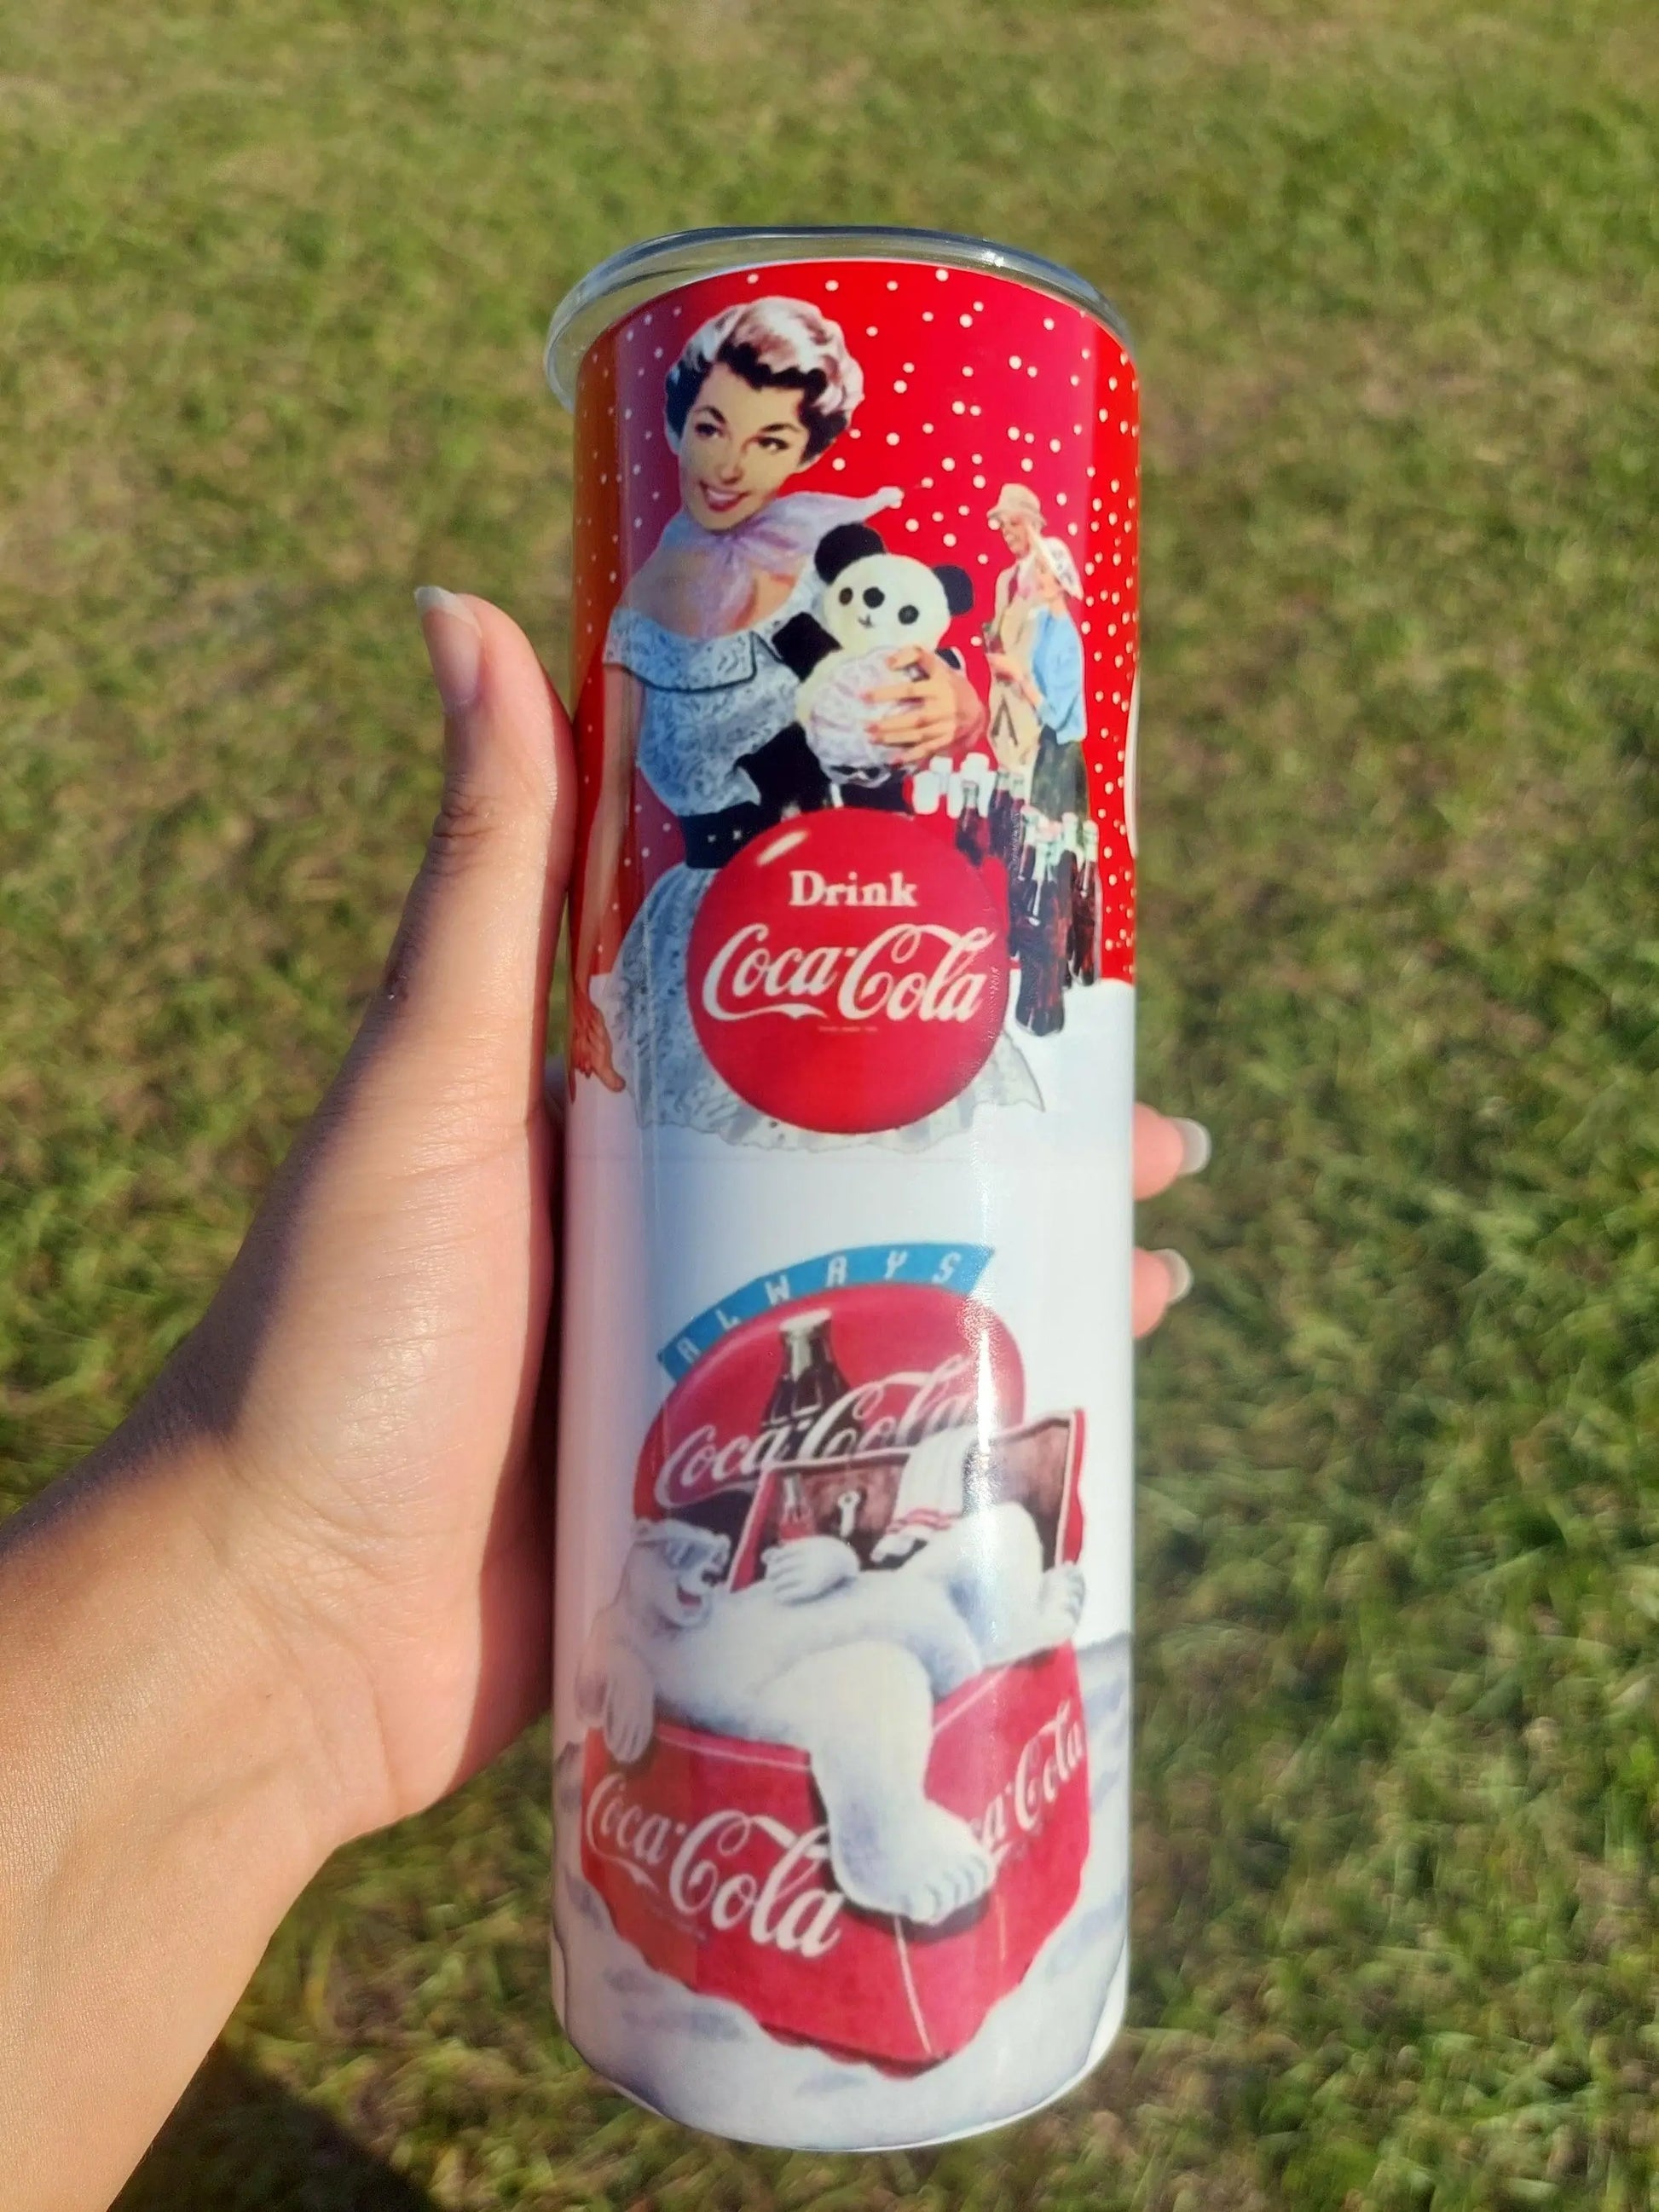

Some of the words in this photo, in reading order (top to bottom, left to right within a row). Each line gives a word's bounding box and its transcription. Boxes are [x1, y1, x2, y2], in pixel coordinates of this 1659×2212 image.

[788, 869, 918, 907] Drink
[702, 922, 997, 1021] Coca-Cola
[677, 1250, 962, 1364] ALWAYS
